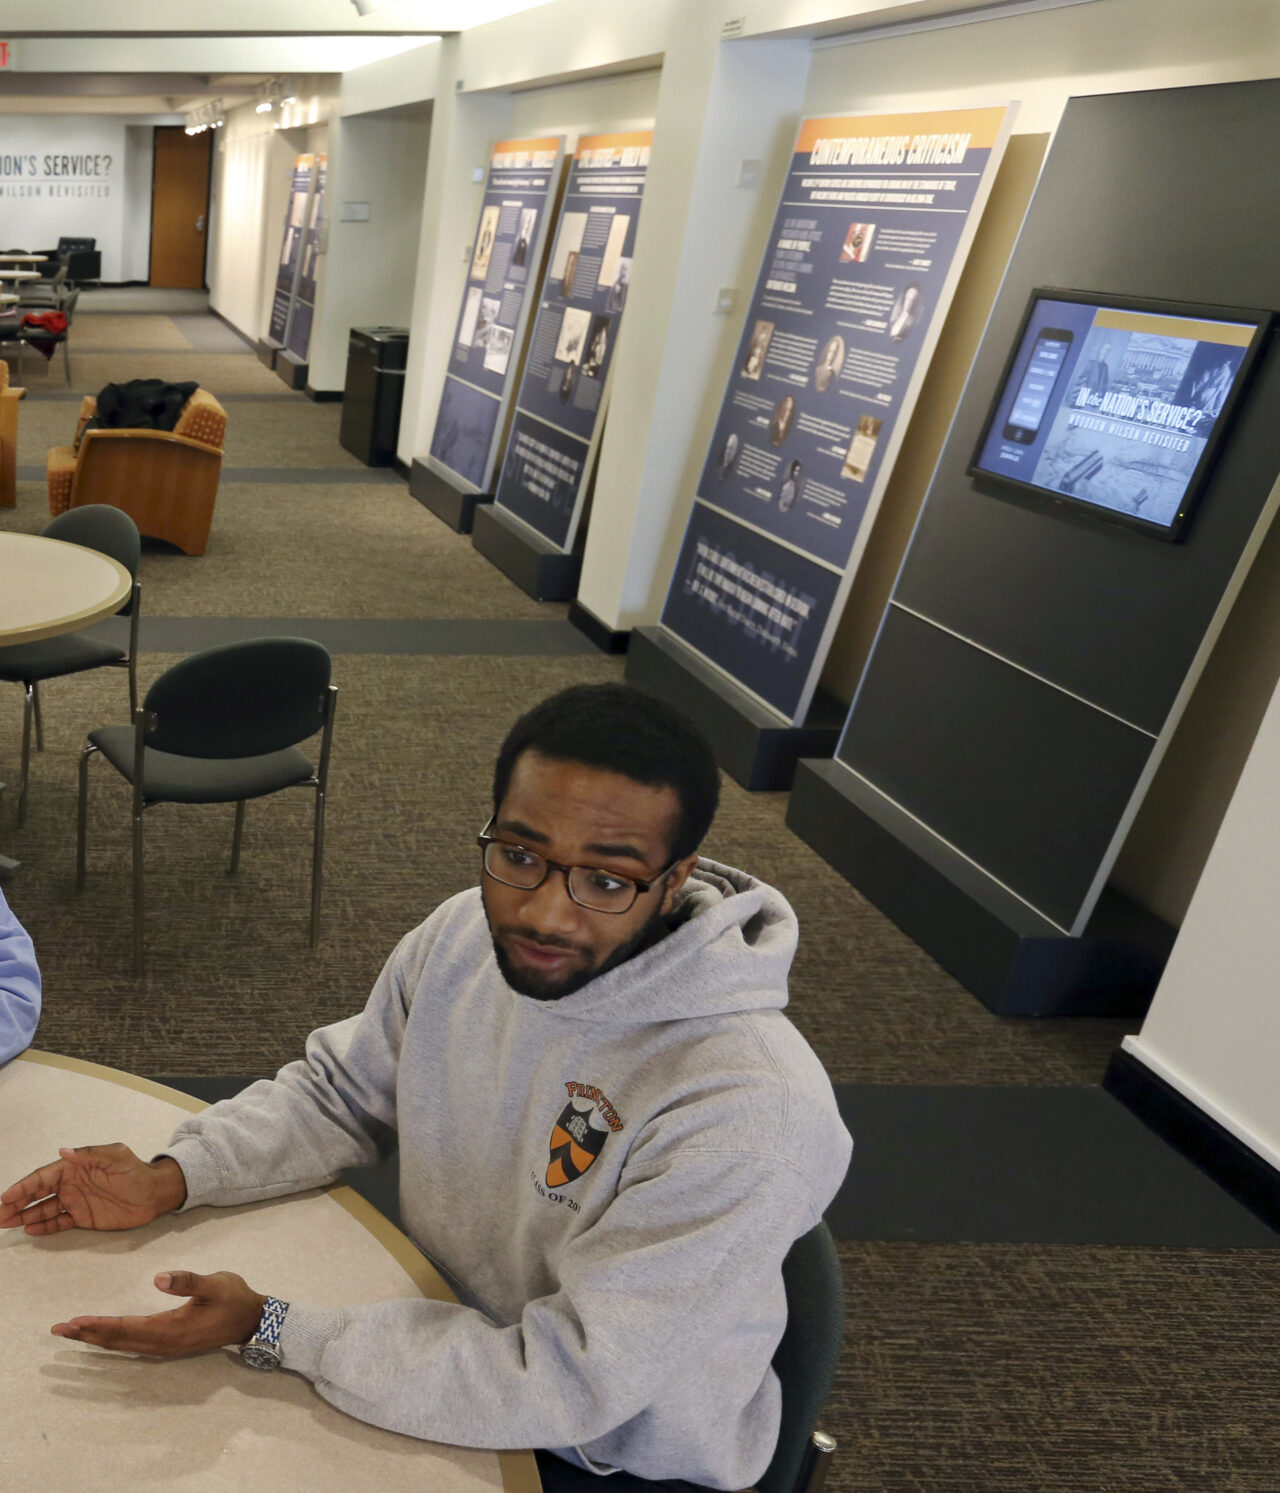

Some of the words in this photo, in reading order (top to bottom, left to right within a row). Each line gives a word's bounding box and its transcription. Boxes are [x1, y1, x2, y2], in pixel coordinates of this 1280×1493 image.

[43, 154, 113, 176] SERVICE?
[809, 135, 911, 166] CONTEMPORANEOUS
[906, 133, 972, 165] CRITICISM
[49, 185, 111, 198] REVISITED
[1075, 387, 1091, 407] IN
[1087, 392, 1102, 407] the
[1099, 391, 1149, 419] NATION'S
[1147, 401, 1203, 431] SERVICE?
[1068, 414, 1107, 432] WOODROW
[1108, 421, 1140, 441] WILSON
[1141, 431, 1191, 453] REVISITED
[565, 1081, 624, 1132] PRINTON
[548, 1192, 567, 1203] OF
